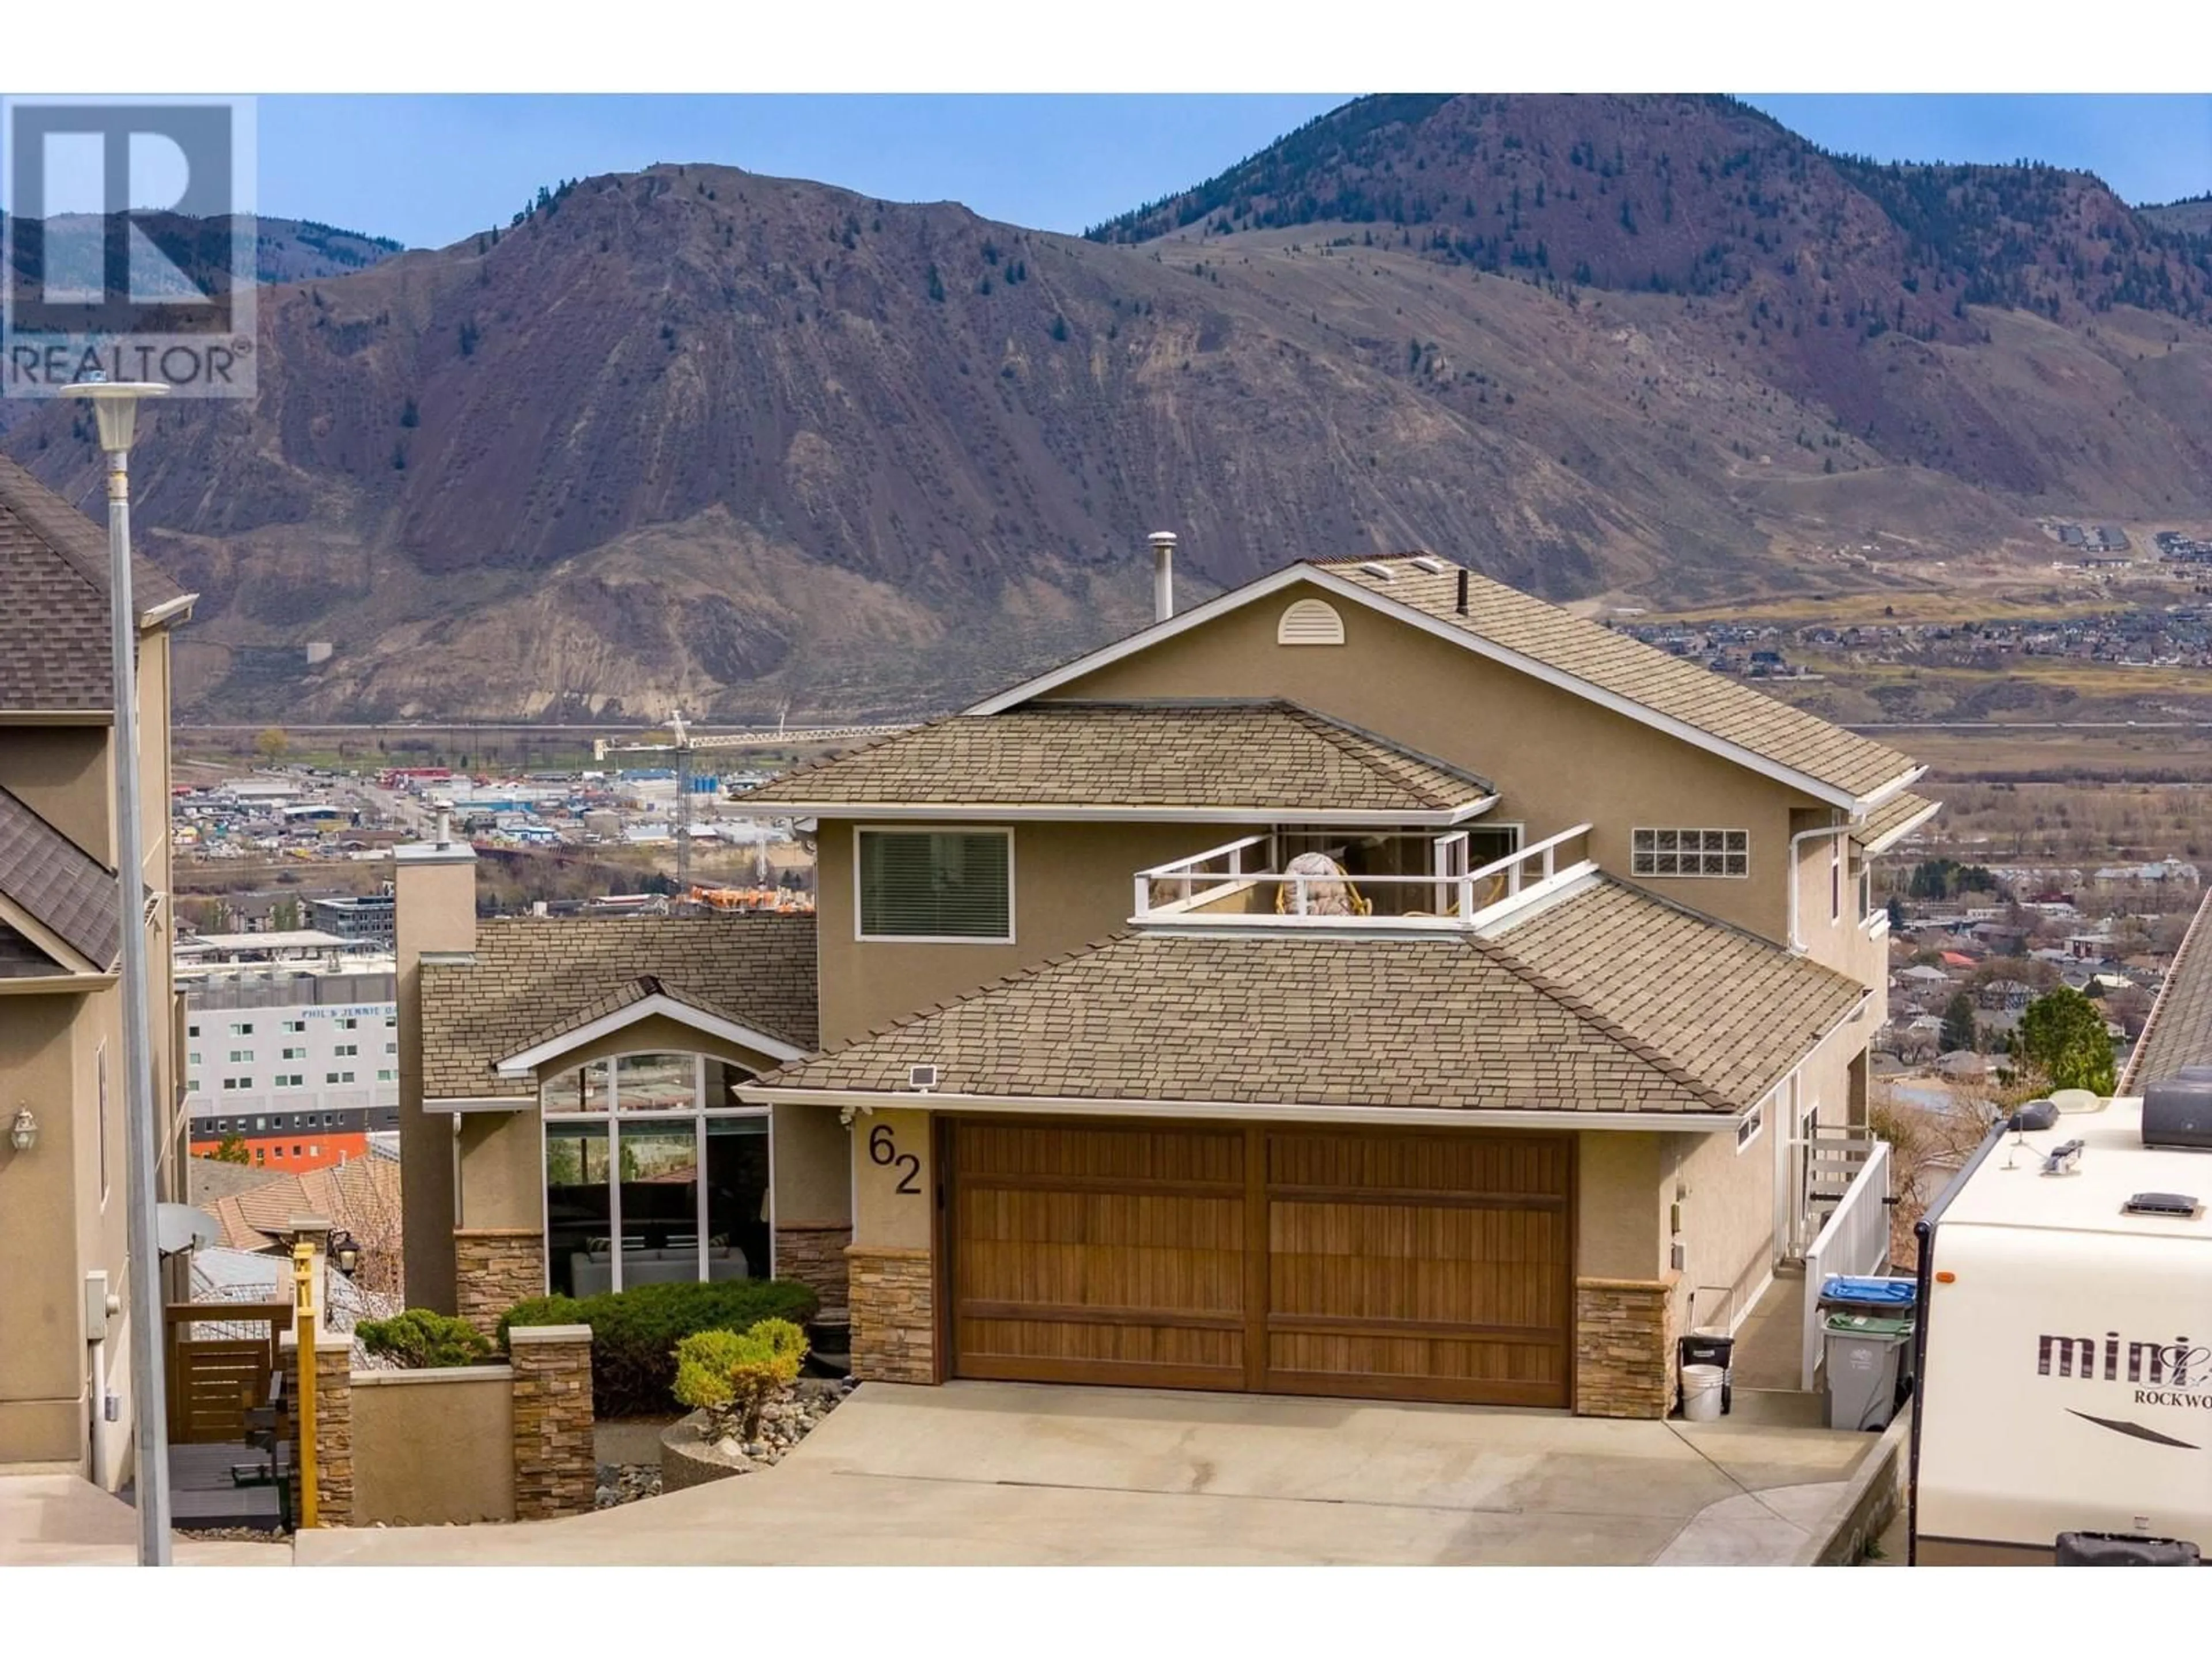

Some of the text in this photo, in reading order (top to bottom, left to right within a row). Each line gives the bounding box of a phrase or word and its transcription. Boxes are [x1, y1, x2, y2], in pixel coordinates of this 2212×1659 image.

[301, 1009, 325, 1018] PHIL
[869, 1124, 921, 1194] 62
[2037, 1331, 2189, 1386] mini
